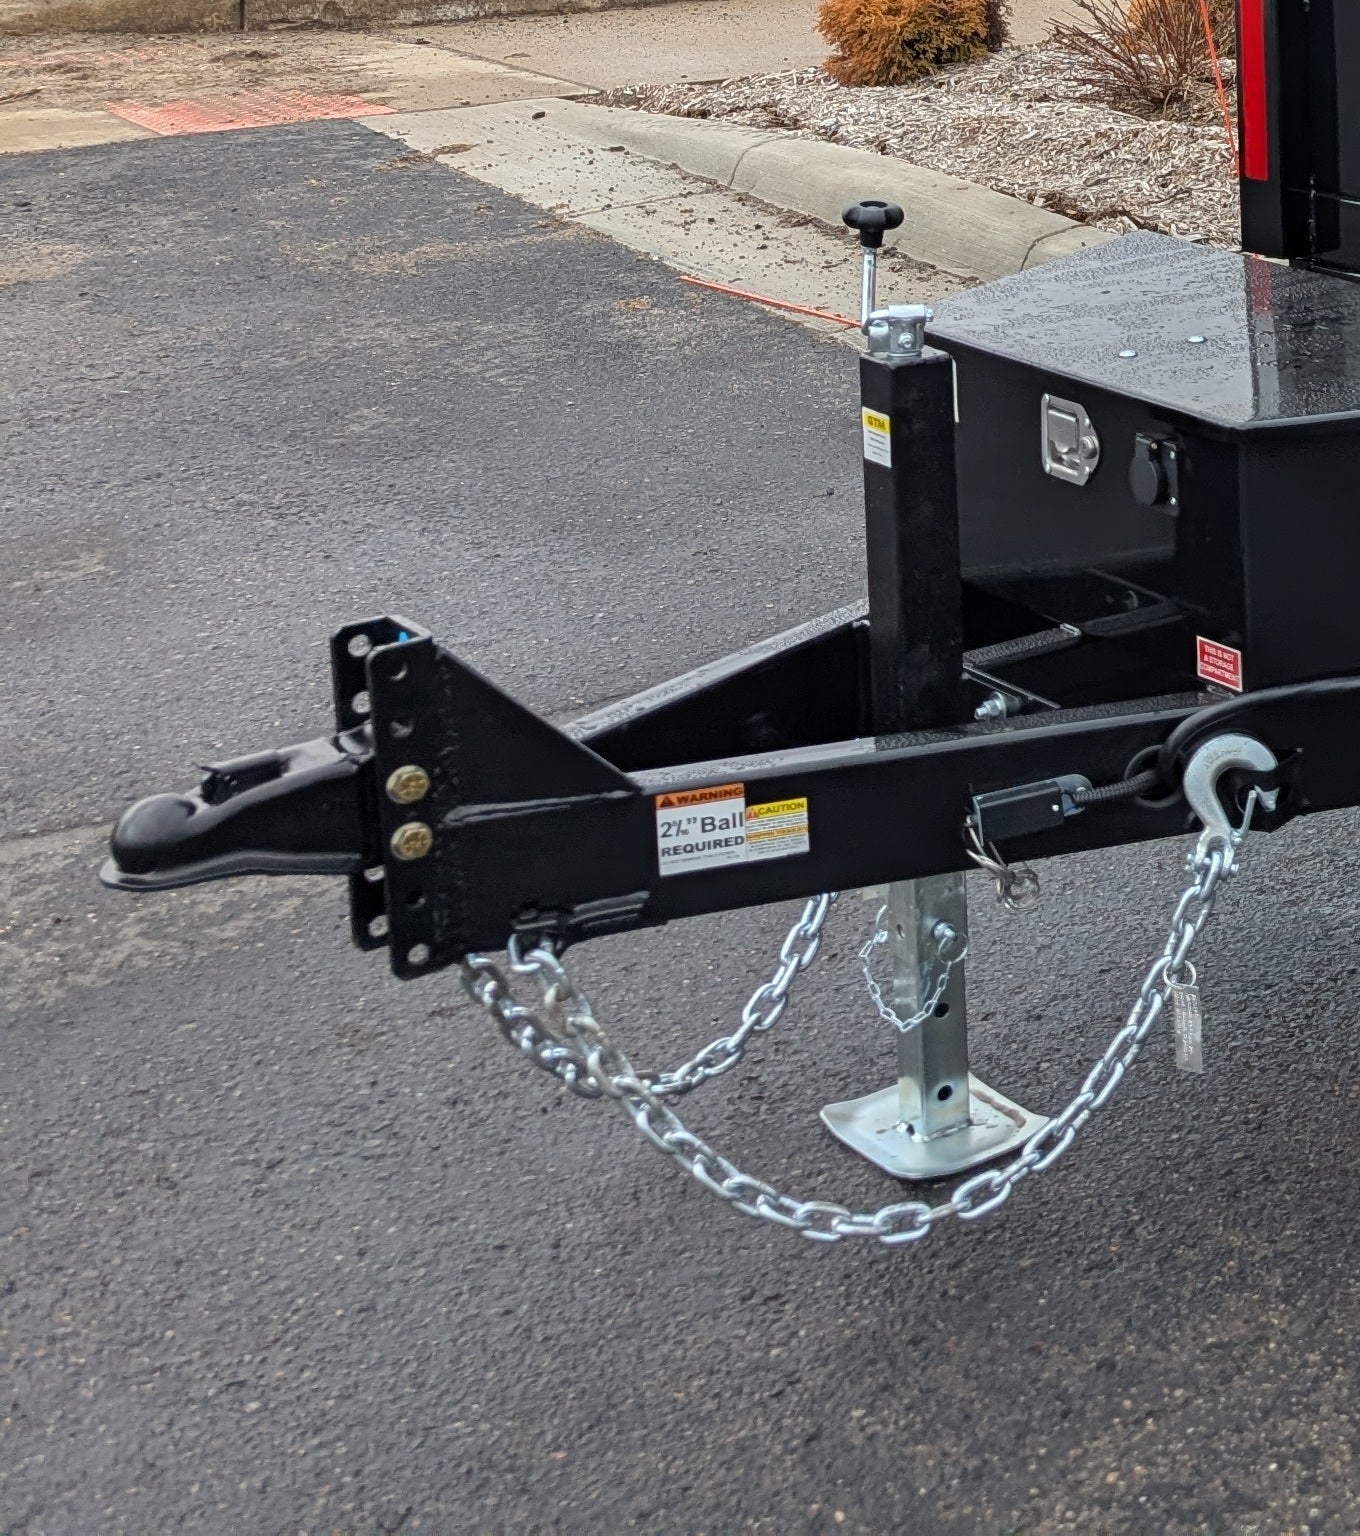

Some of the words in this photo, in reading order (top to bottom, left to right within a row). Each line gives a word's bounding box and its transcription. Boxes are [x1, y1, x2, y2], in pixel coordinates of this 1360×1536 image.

[1203, 644, 1217, 655] THIS
[1200, 661, 1241, 681] COMPARTMENT
[1209, 655, 1234, 672] STORAGE
[676, 786, 744, 805] WARNING
[758, 801, 805, 816] CAUTION
[701, 811, 744, 834] Ball
[661, 834, 745, 858] REQUIRED
